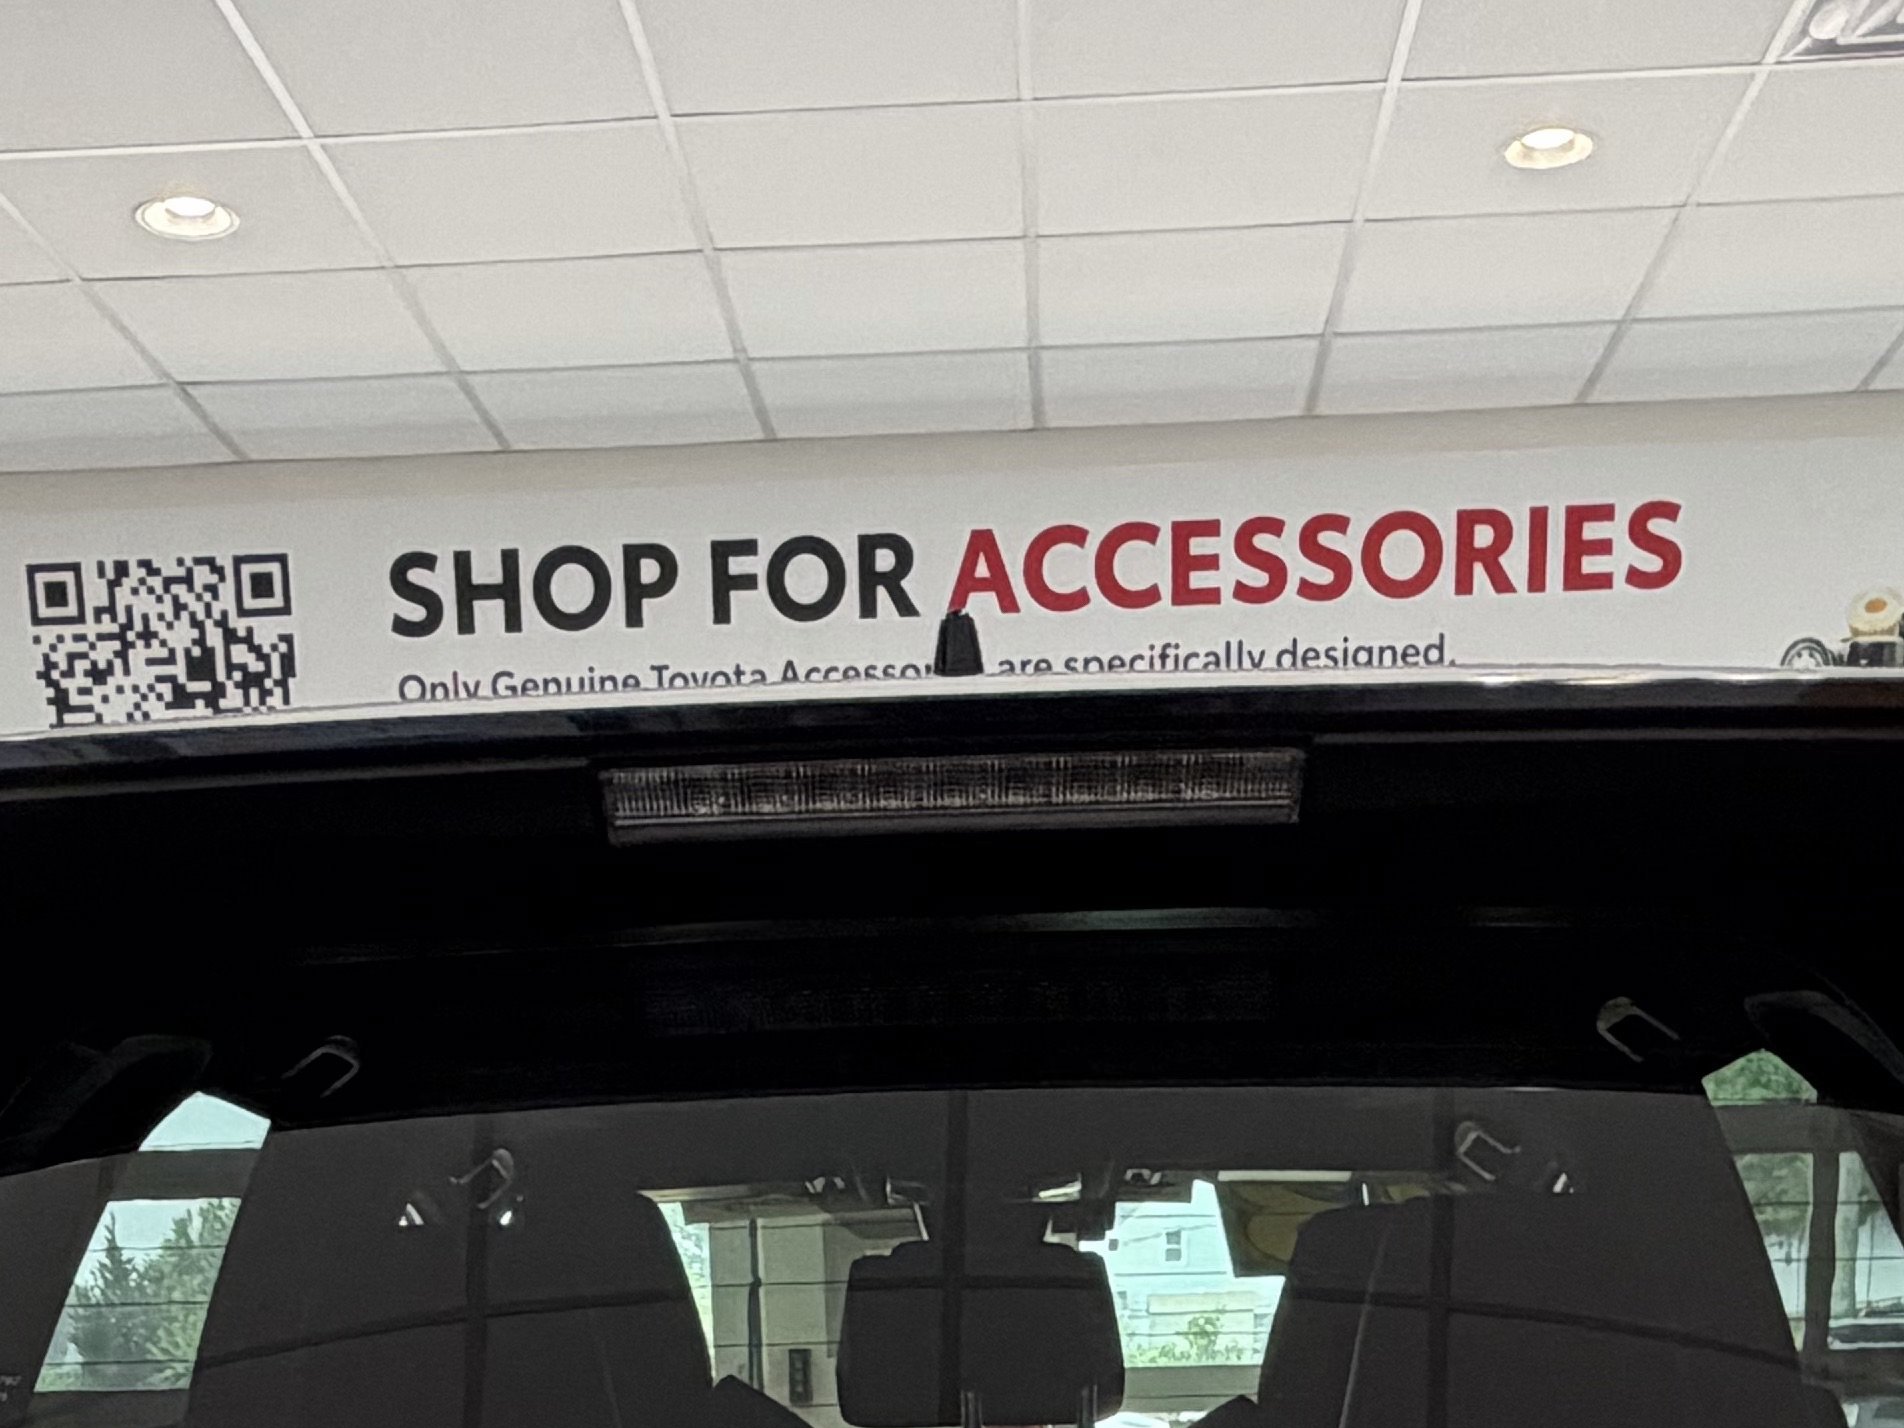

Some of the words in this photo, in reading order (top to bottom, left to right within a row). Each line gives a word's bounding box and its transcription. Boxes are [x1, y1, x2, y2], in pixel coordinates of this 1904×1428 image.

[389, 542, 678, 638] SHOP
[710, 532, 922, 625] FOR
[947, 500, 1683, 615] ACCESSORIES
[398, 670, 481, 701] Only
[491, 666, 642, 698] Genuine
[649, 663, 768, 690] Toyota
[997, 655, 1053, 676] are
